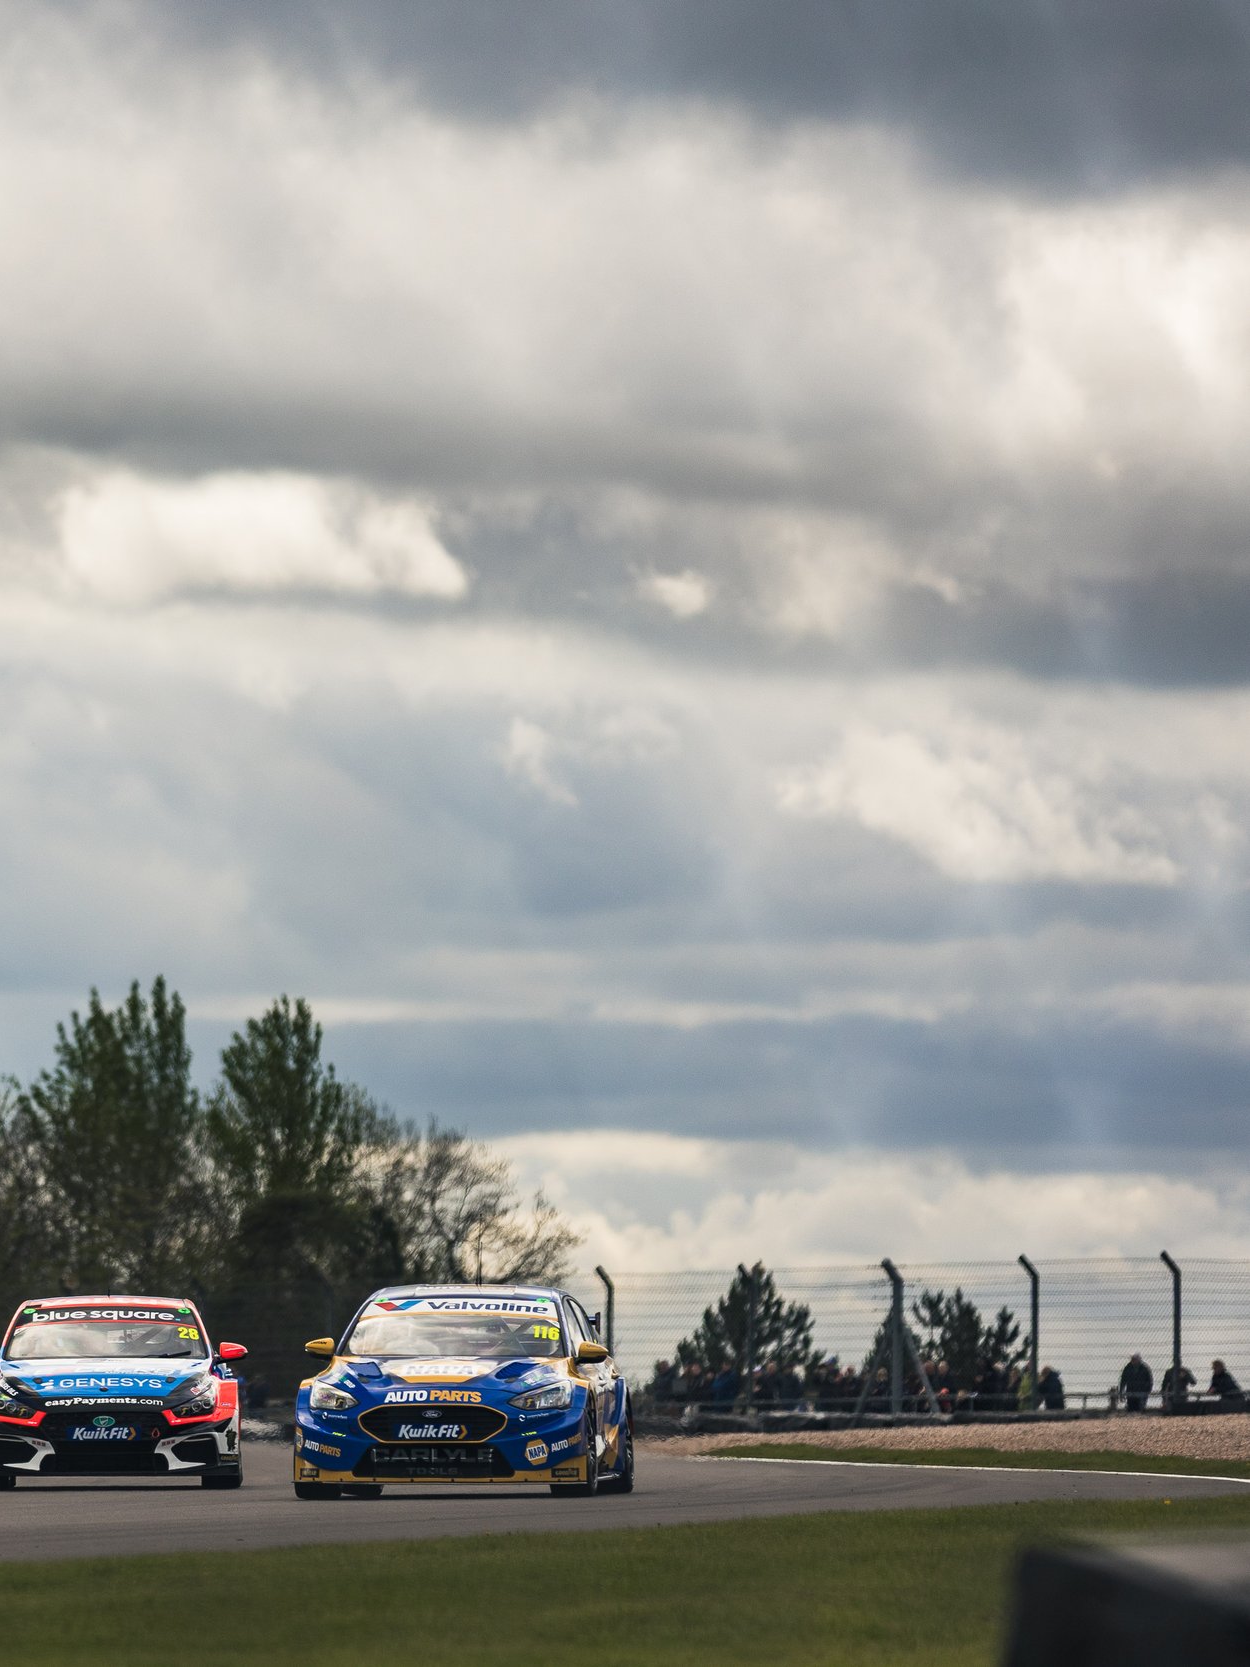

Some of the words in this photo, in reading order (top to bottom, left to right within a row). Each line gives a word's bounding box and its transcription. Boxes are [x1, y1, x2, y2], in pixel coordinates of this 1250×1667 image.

[428, 1301, 548, 1314] Valvoline
[32, 1310, 87, 1322] blue
[177, 1327, 200, 1341] 28
[533, 1325, 560, 1341] 116
[59, 1377, 162, 1389] GENESYS
[45, 1397, 164, 1407] easyPayments.com
[384, 1390, 428, 1403] AUTO
[430, 1390, 482, 1403] PARTS
[304, 1439, 319, 1452] AUTO
[319, 1444, 342, 1457] PARTS
[527, 1444, 547, 1459] NAPA
[551, 1439, 569, 1453] AUTO
